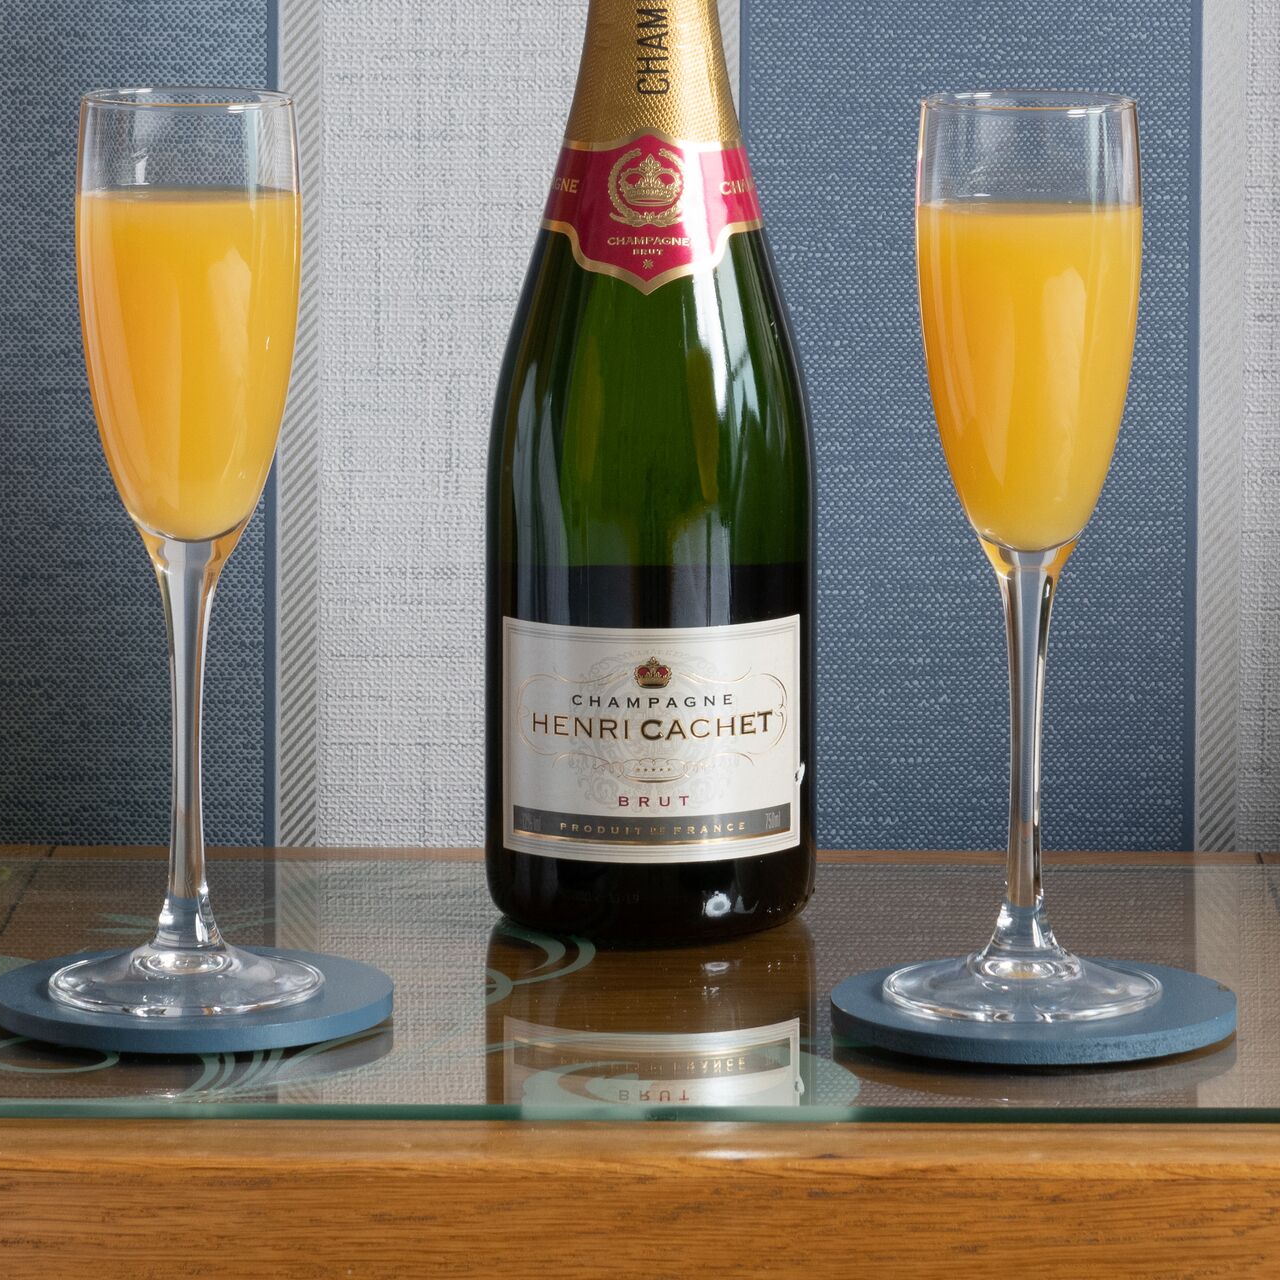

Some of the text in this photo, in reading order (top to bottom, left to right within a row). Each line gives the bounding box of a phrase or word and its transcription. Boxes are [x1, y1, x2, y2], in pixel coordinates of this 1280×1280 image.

[607, 236, 690, 247] CHAMPAGNE
[632, 248, 663, 256] BRUT
[572, 694, 733, 709] CHAMPAGNE
[532, 709, 774, 741] HENRI CACHET
[618, 795, 690, 807] BRUT
[559, 822, 640, 835] PRODUIT
[673, 821, 746, 835] FRANCE
